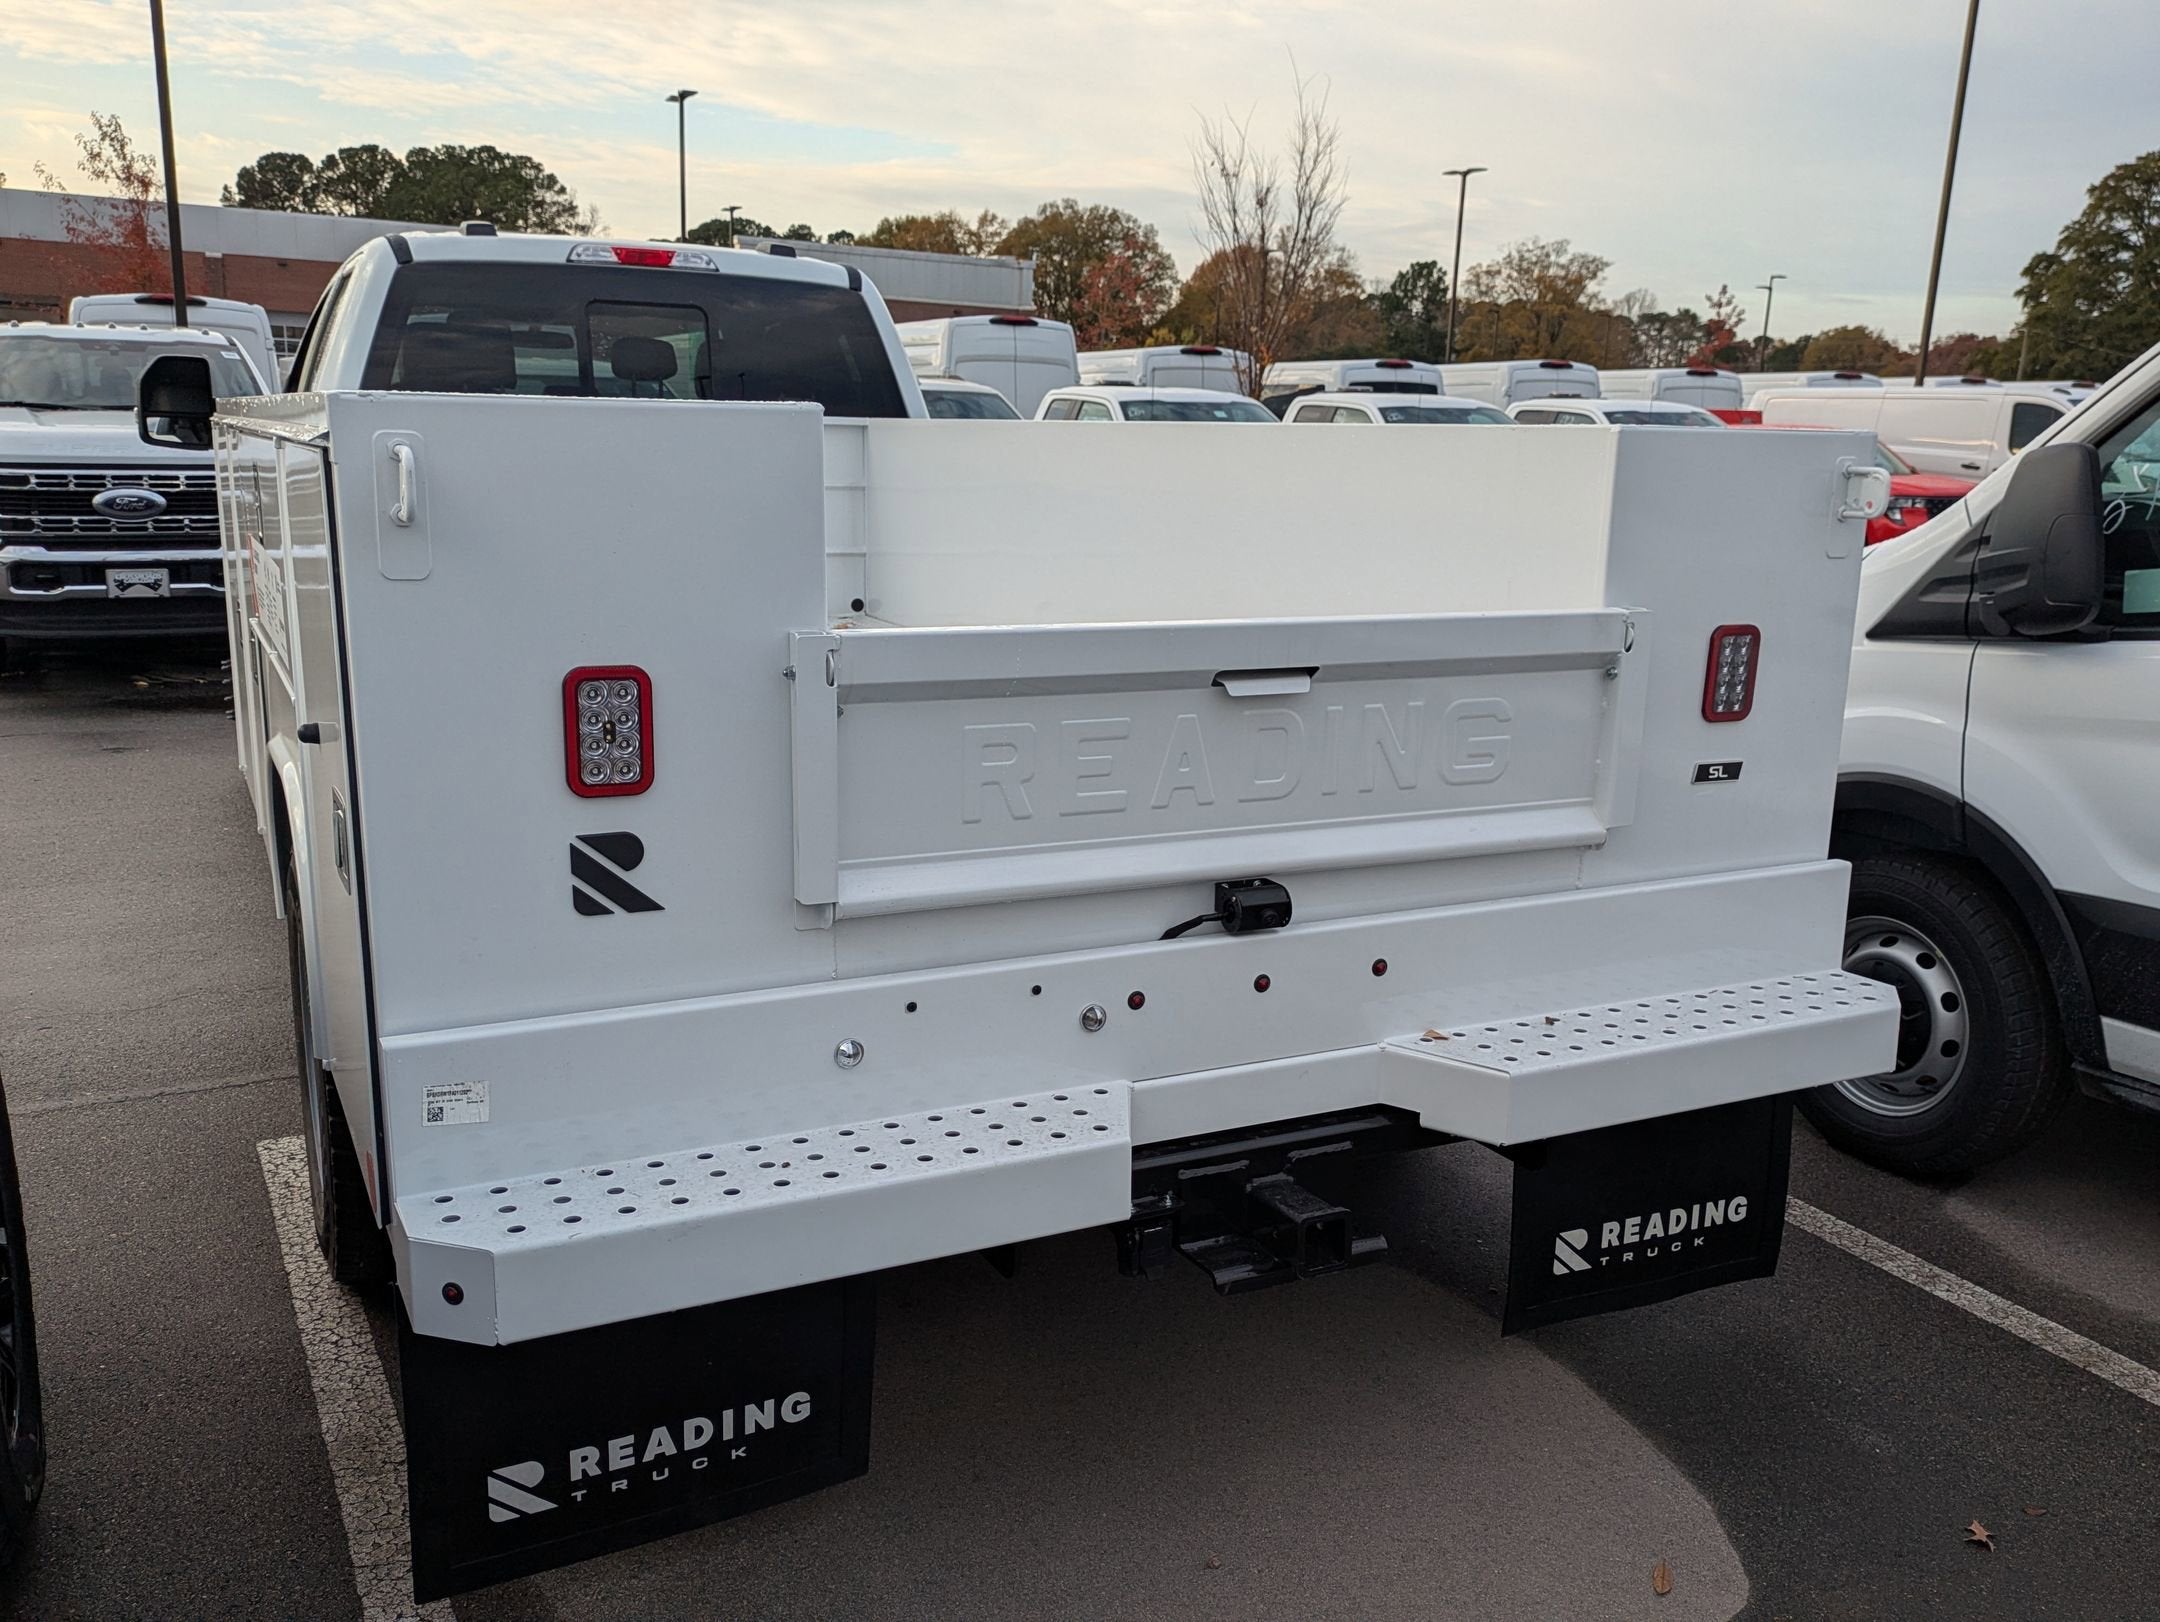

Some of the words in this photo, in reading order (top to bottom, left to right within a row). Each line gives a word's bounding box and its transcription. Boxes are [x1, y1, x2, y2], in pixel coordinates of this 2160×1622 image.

[112, 497, 147, 511] Ford
[962, 697, 1513, 825] READING
[1708, 765, 1729, 779] SL
[1600, 1195, 1748, 1250] READING
[1600, 1236, 1705, 1267] TRUCK
[568, 1391, 812, 1482] READING
[570, 1445, 748, 1502] TRUCK
